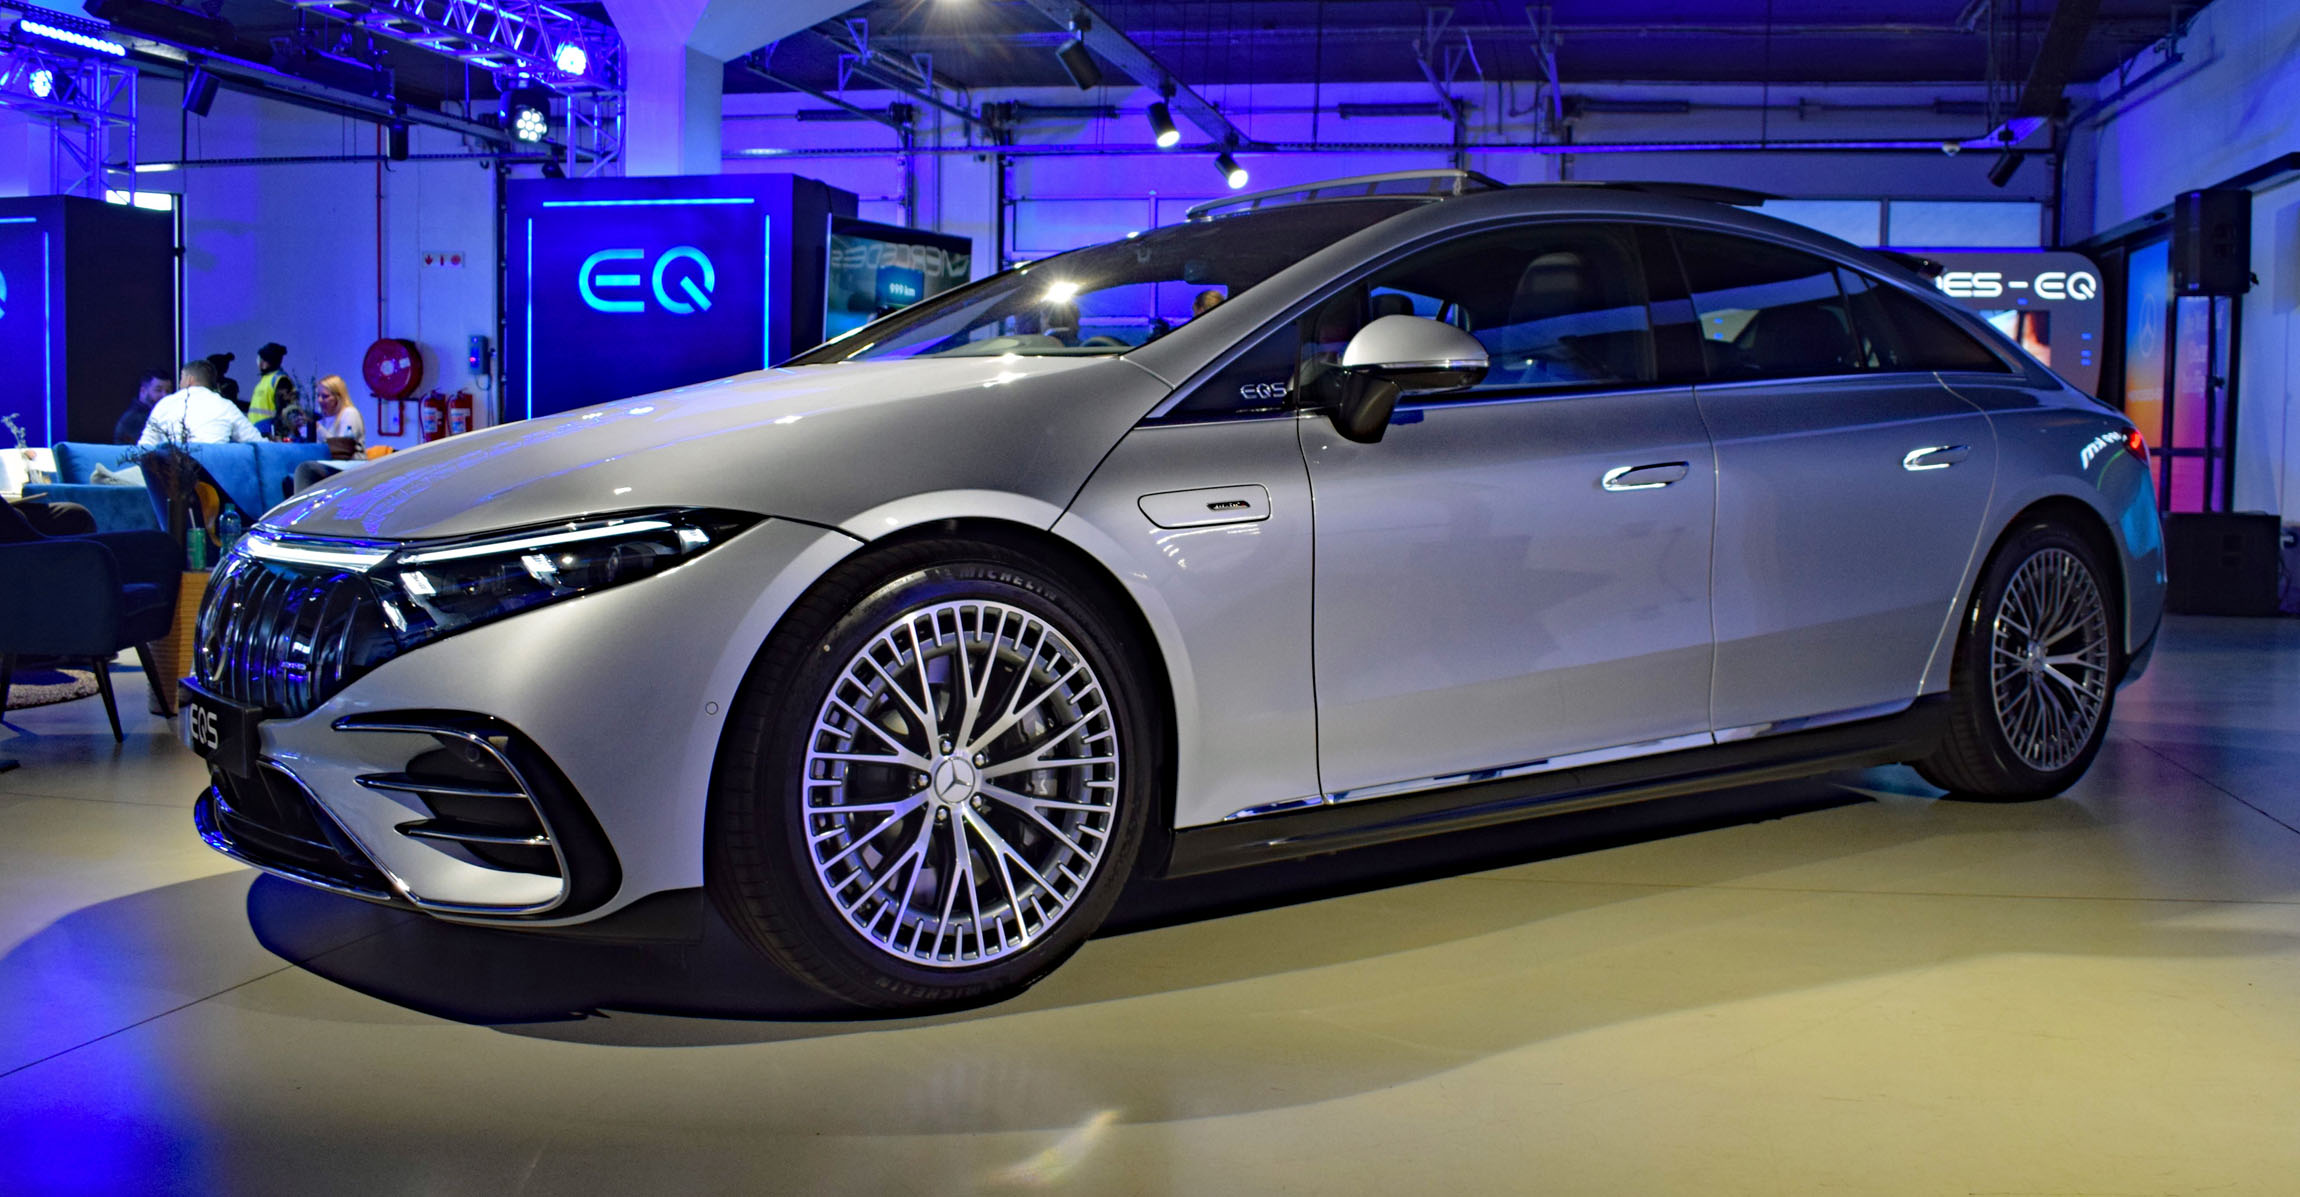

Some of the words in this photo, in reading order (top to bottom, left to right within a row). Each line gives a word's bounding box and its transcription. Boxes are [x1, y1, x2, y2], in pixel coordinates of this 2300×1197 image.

[579, 246, 715, 314] EQ
[1935, 271, 2003, 298] ES
[2034, 271, 2097, 300] EQ
[1240, 383, 1287, 399] EQS
[959, 566, 1057, 601] MICHELIN
[190, 703, 219, 750] EQS
